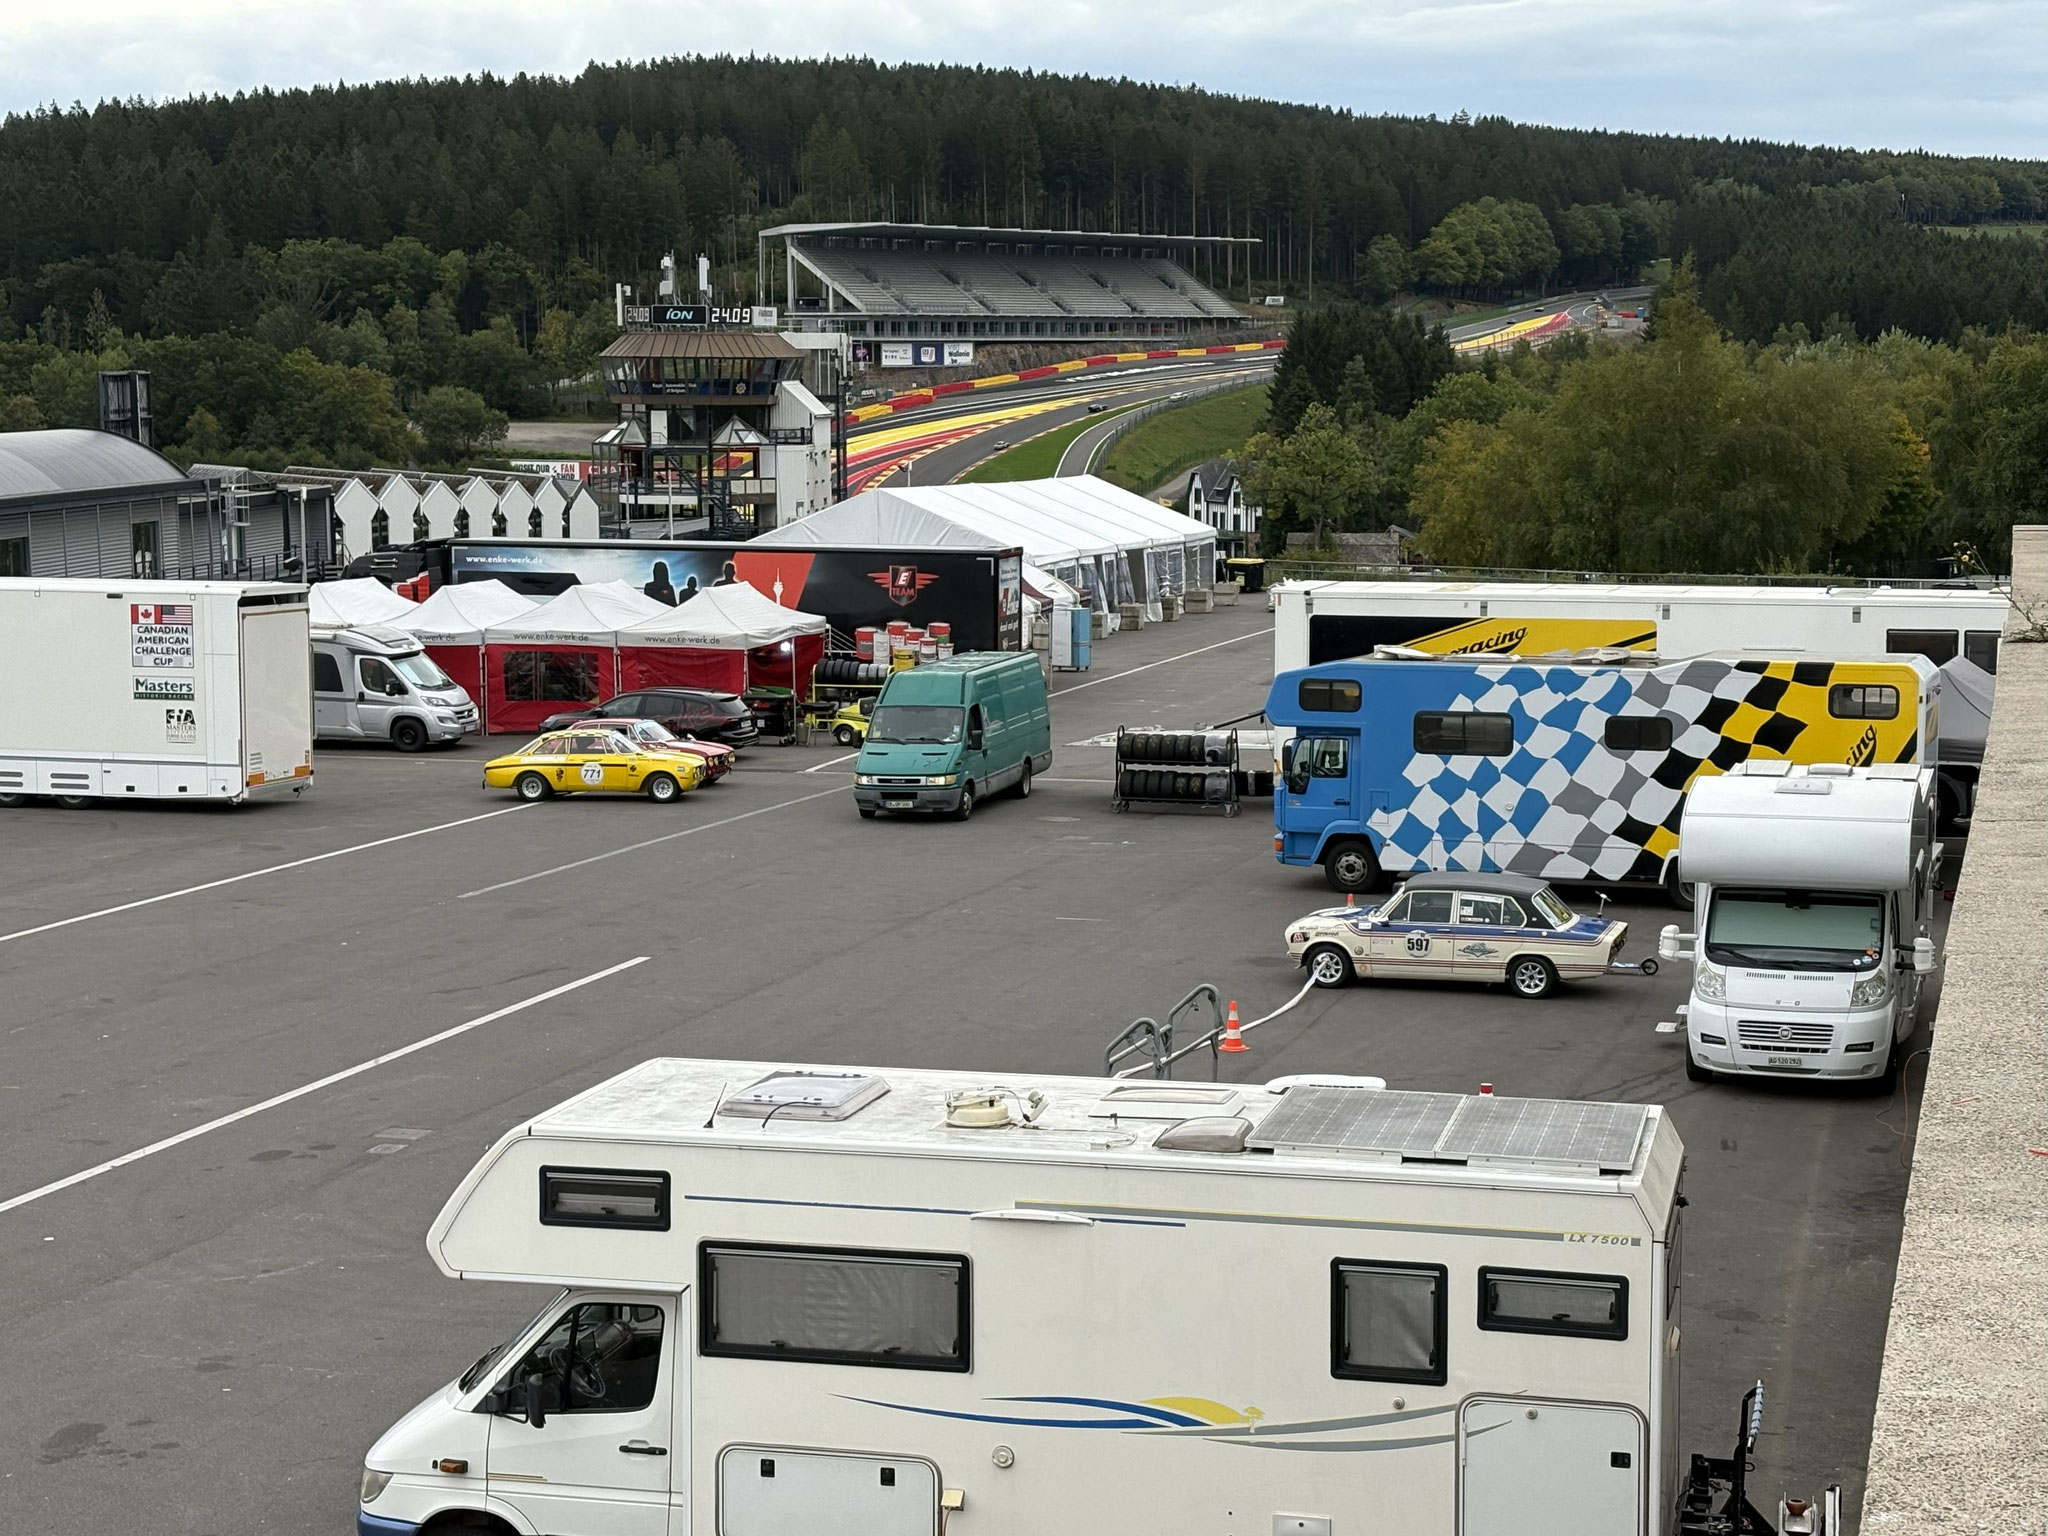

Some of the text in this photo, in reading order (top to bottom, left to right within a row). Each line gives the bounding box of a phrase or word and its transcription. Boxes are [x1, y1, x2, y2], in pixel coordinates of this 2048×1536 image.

[711, 307, 750, 323] 24.09
[561, 464, 575, 472] FAN
[466, 556, 543, 565] www.enke-werk.de
[891, 588, 915, 596] TEAM
[137, 626, 188, 634] CANADIAN
[137, 636, 189, 645] AMERICAN
[513, 632, 589, 642] www.enke-werk.de
[644, 634, 721, 645] www.enke-werk.de
[134, 646, 191, 655] CHALLENGE
[153, 657, 173, 666] CUP
[135, 678, 193, 692] Masters
[583, 769, 601, 779] 771
[1407, 938, 1430, 951] 597
[1568, 1234, 1629, 1246] LX 7500
